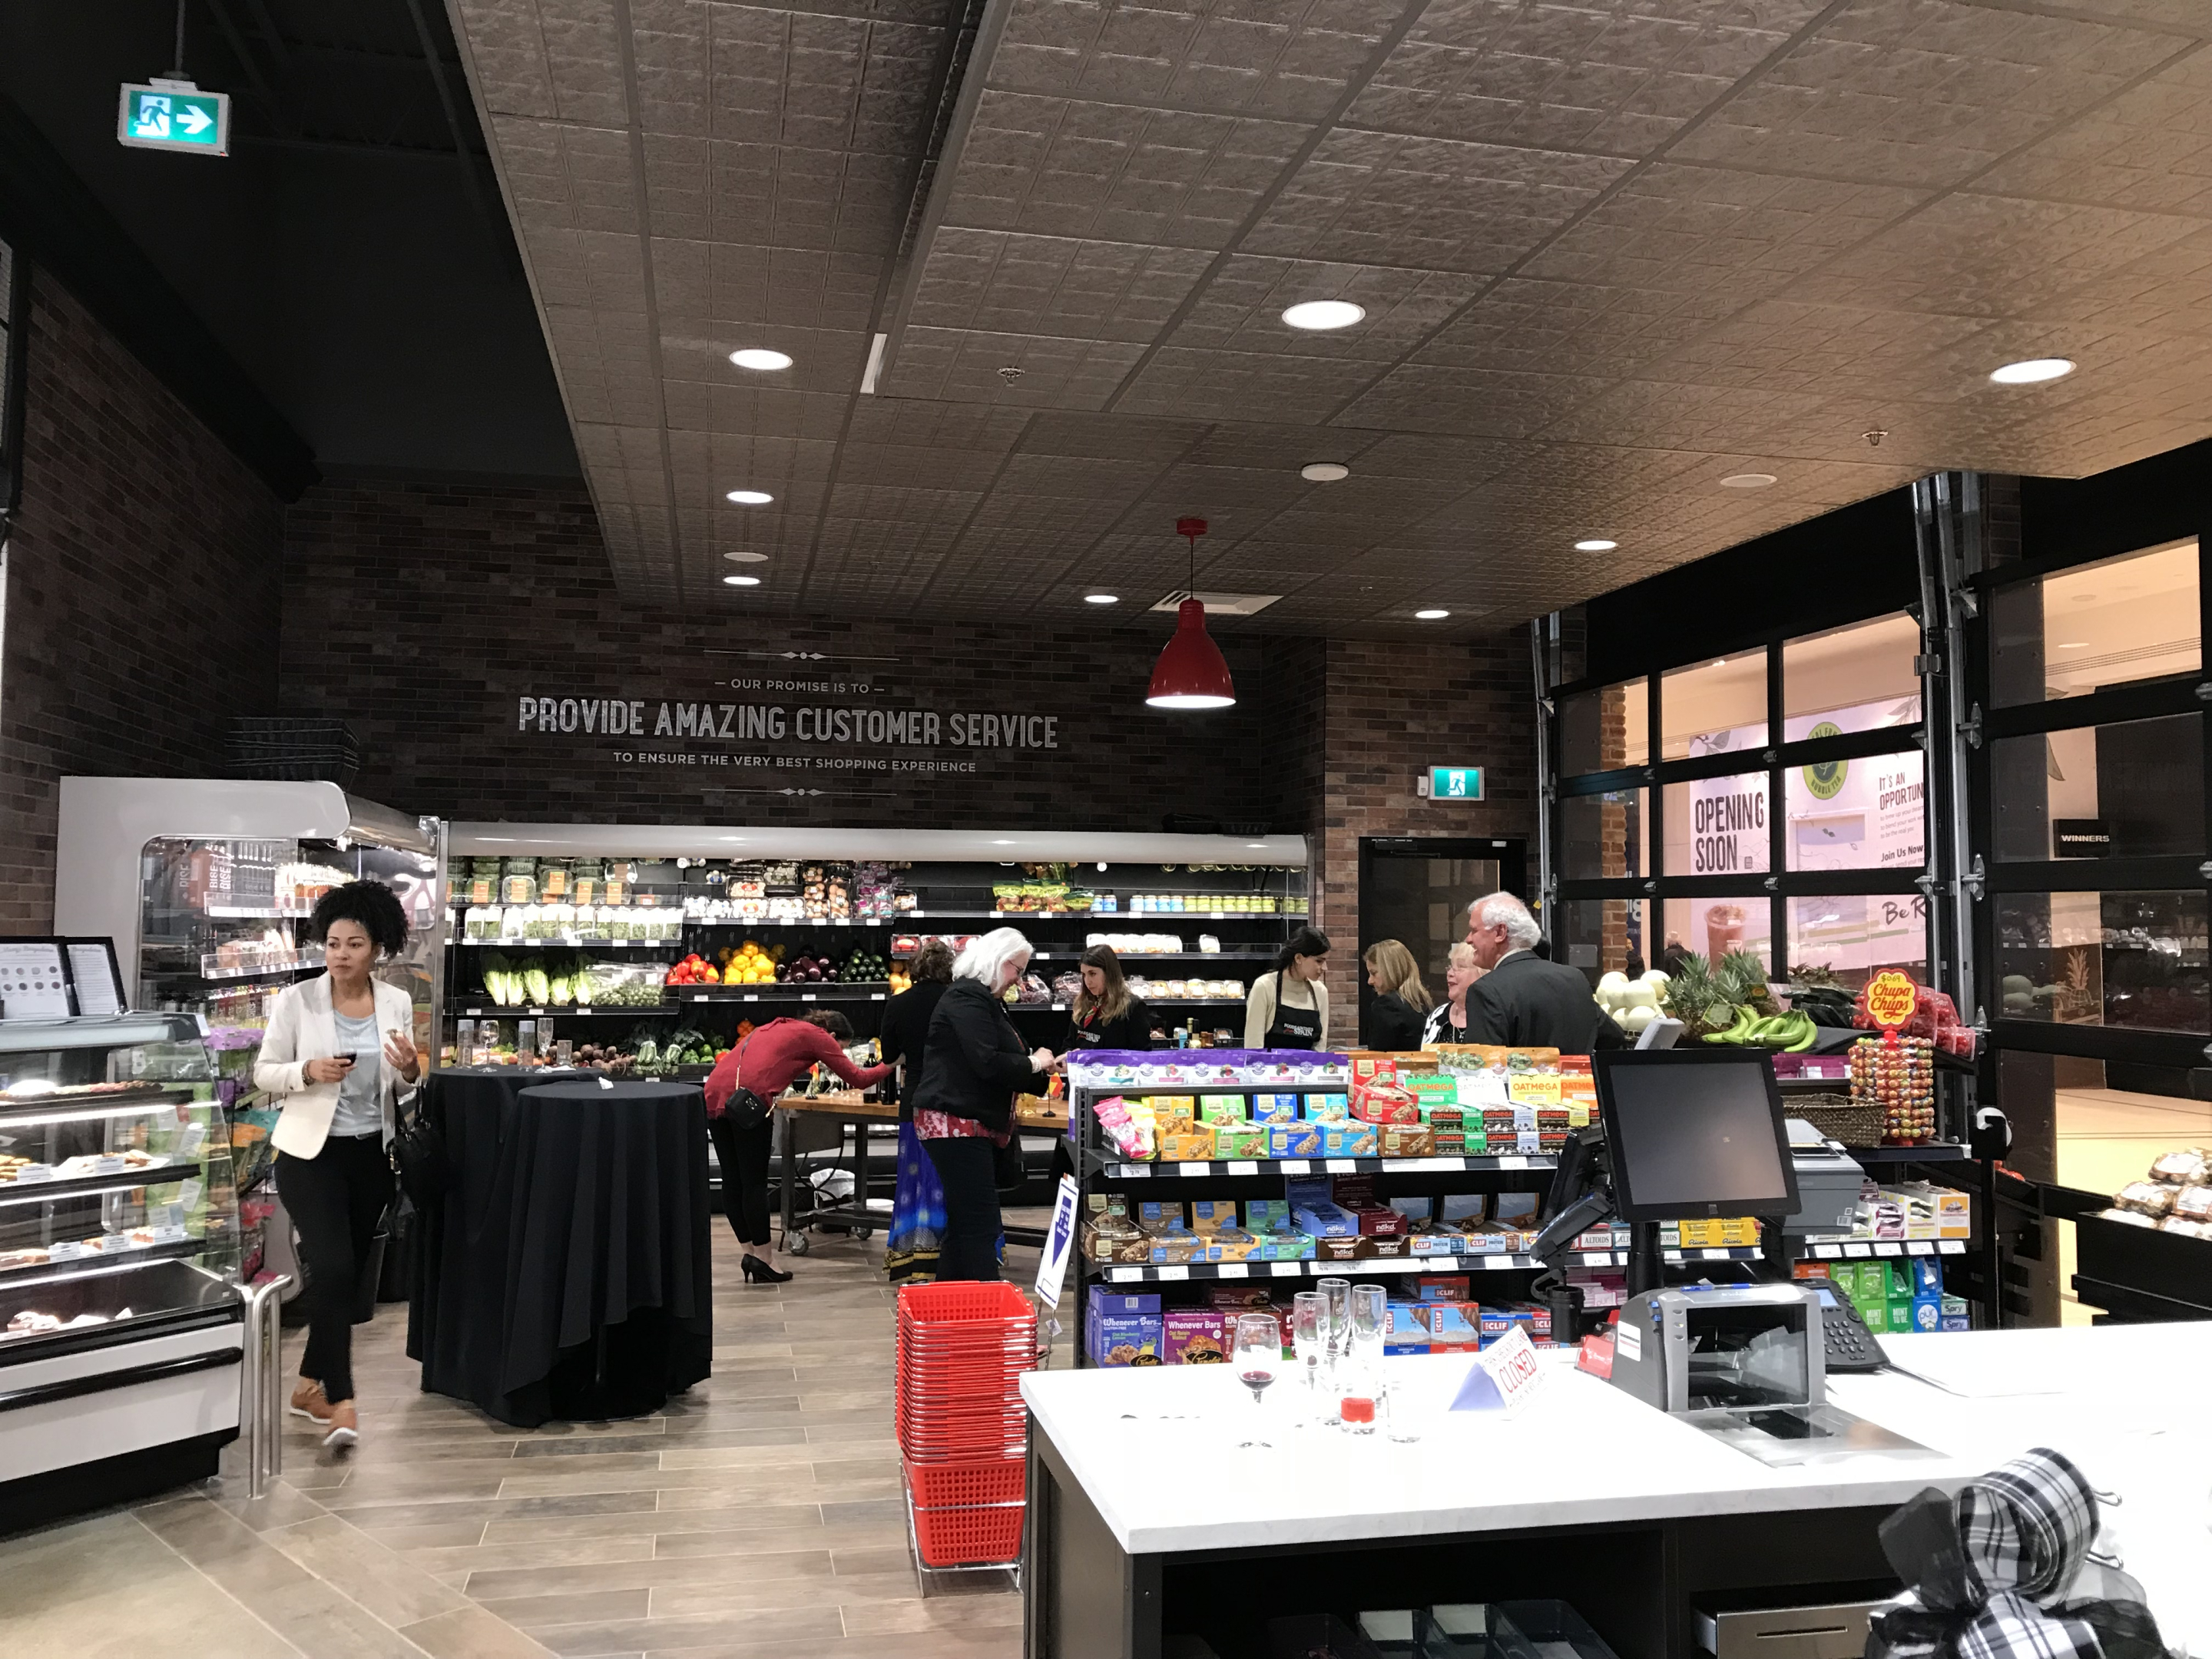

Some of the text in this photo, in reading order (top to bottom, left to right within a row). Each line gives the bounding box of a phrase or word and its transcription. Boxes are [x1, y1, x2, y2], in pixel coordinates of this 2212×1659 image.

[731, 678, 869, 694] OUR PROMISE IS TO
[518, 696, 1058, 748] PROVIDE AMAZING CUSTOMER SERVICE
[614, 752, 976, 773] TO ENSURE THE VERY BEST SHOPPING EXPERIENCE
[1879, 772, 1905, 791] IT'S AN
[1879, 782, 1924, 810] OPPORTUN
[1695, 791, 1764, 833] OPENING
[1695, 834, 1737, 872] SOON
[1881, 850, 1895, 862] Join
[1896, 847, 1906, 858] Us
[1882, 901, 1910, 926] Be
[1873, 983, 1911, 997] Chupa
[1870, 997, 1909, 1013] Chups
[1103, 1316, 1157, 1326] Whenever Bars
[1892, 1307, 1908, 1316] MINT
[1498, 1348, 1537, 1393] CLOSED
